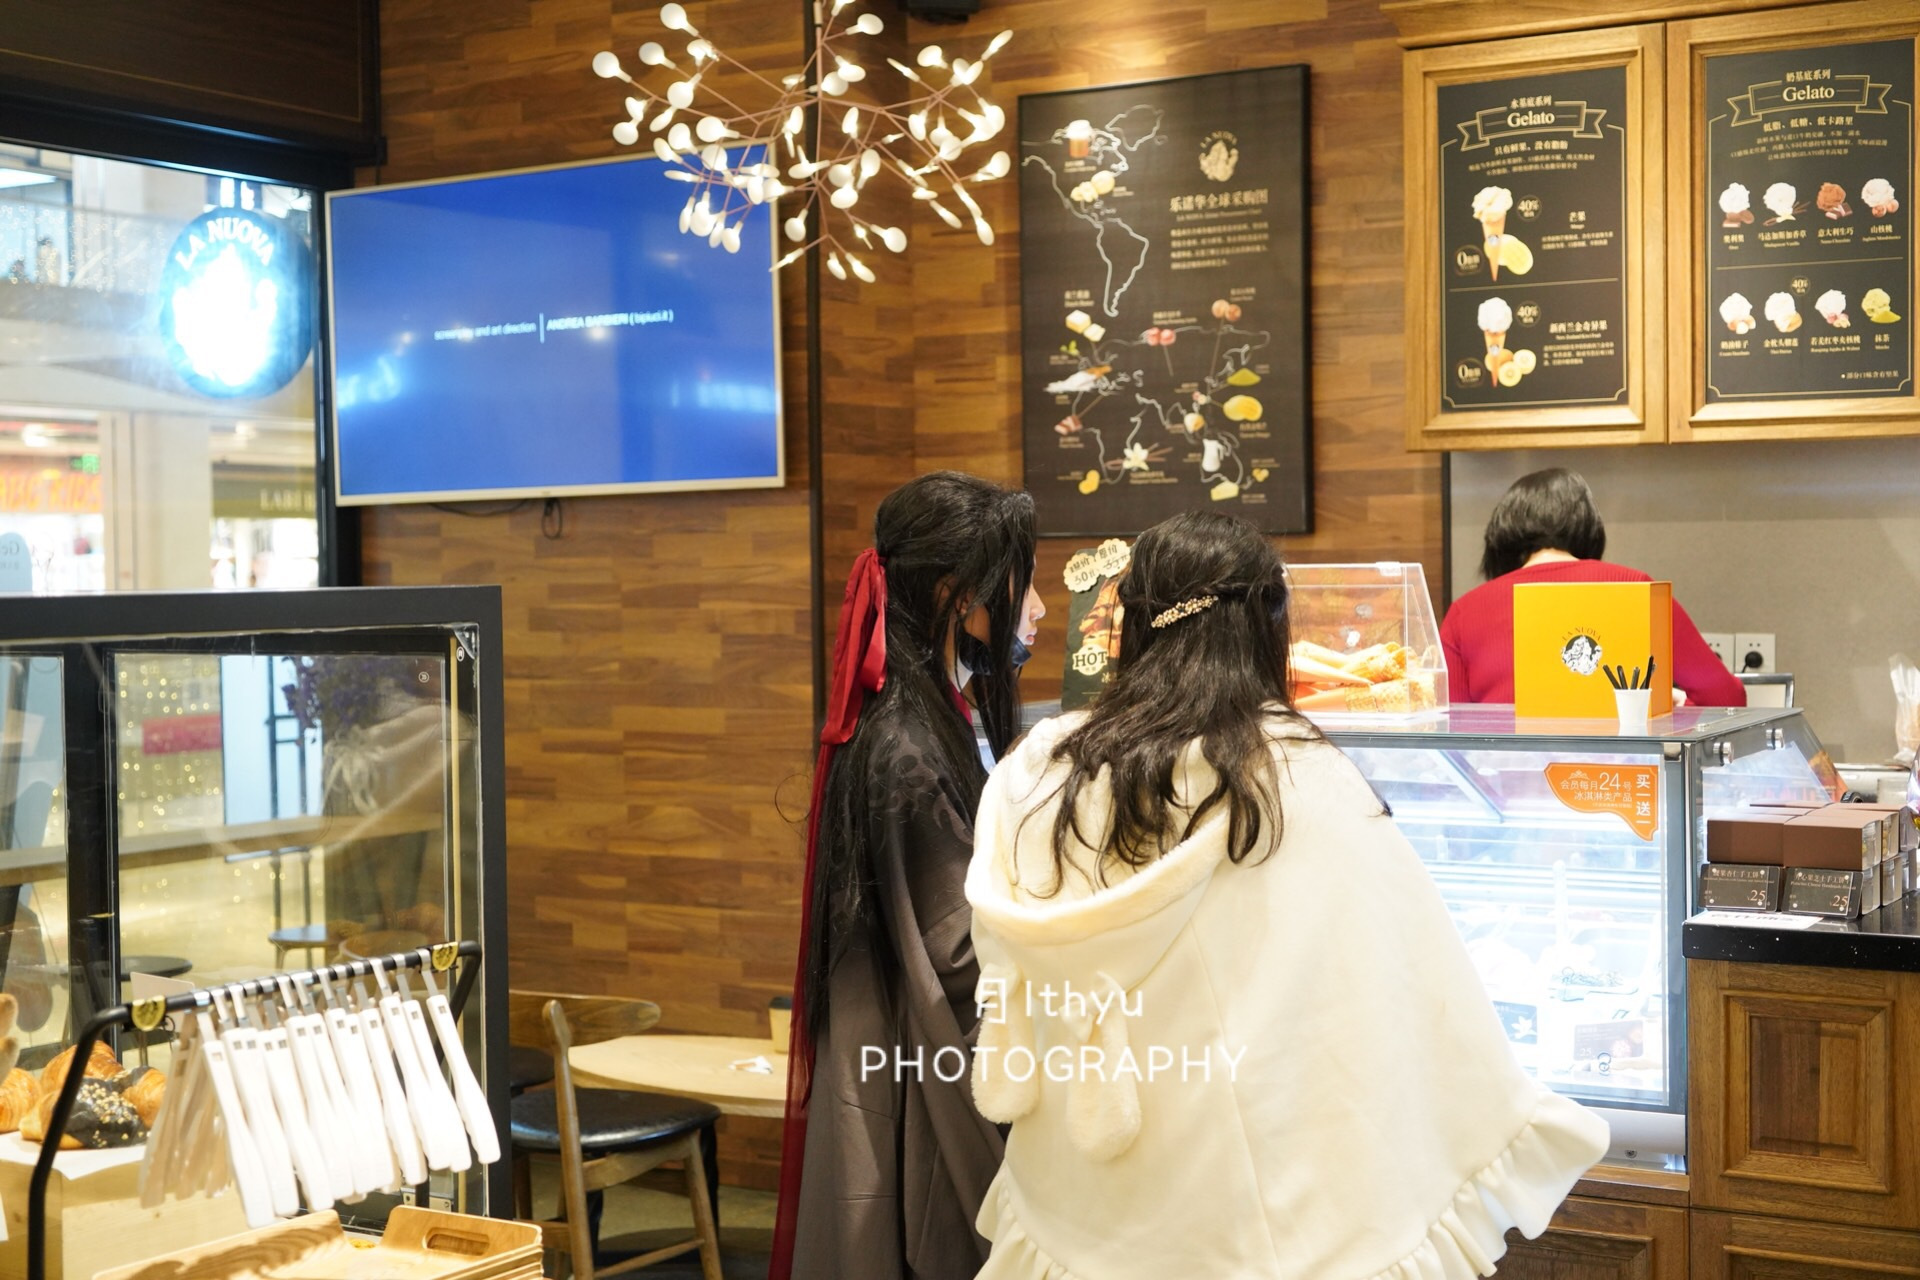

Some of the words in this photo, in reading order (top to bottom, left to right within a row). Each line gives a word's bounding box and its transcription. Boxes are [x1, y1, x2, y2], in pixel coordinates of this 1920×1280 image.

[1786, 69, 1831, 82] 奶基底系列
[1783, 85, 1835, 101] Gelato
[1510, 95, 1552, 109] 水基底系列
[1507, 111, 1555, 127] Gelato
[1518, 200, 1539, 211] 40%
[1570, 211, 1586, 222] 芒果
[175, 234, 206, 271] LA
[206, 216, 275, 266] NUOVA
[1517, 305, 1538, 317] 40%
[546, 316, 585, 331] ANDREA
[585, 313, 629, 328] BARBIERI
[1875, 333, 1890, 343] 抹茶
[1074, 651, 1108, 667] HOT
[1560, 772, 1632, 792] 会员每月24号
[1574, 791, 1632, 803] 冰淇淋类产品
[1636, 773, 1651, 824] 买一送一
